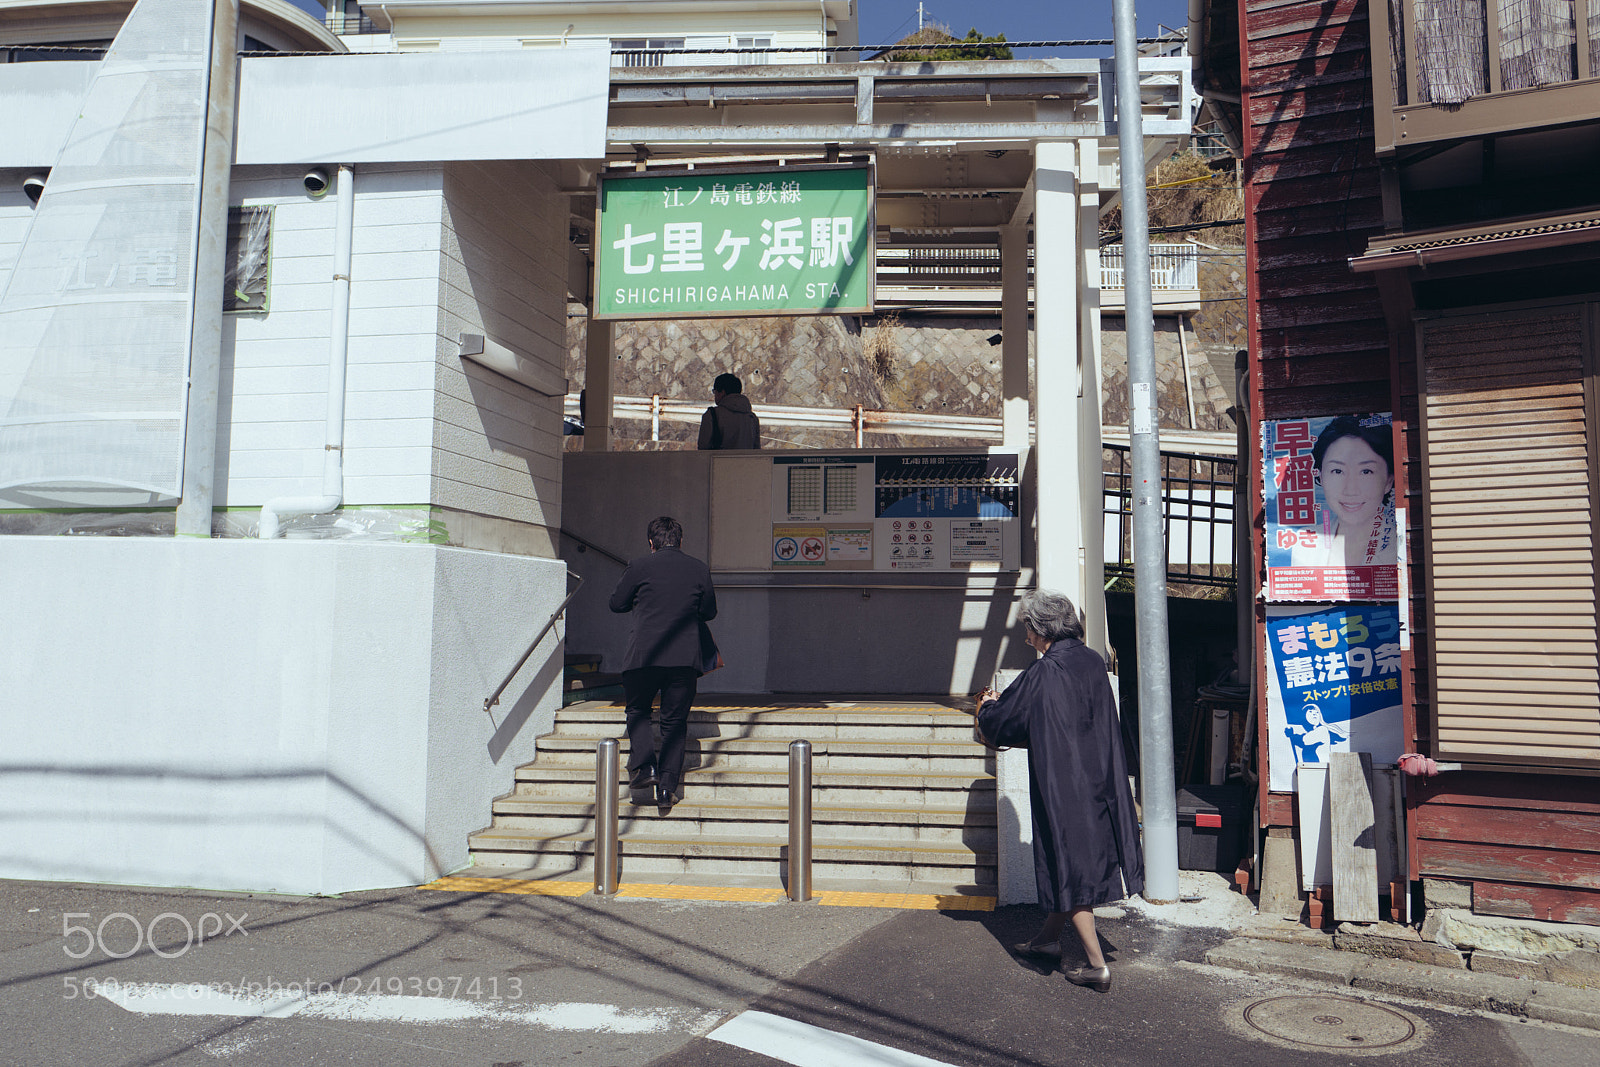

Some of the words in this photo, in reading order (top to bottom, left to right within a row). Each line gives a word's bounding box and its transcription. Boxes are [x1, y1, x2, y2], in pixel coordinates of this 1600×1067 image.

[662, 181, 803, 209] 江ノ島電鉄線
[615, 284, 790, 305] SHICHIRIGAHAMA
[805, 282, 849, 300] STA.
[1273, 421, 1317, 527] 早稲田
[1276, 528, 1318, 550] ゆき
[1277, 610, 1399, 655] まもろう
[1283, 642, 1402, 689] 憲法9条
